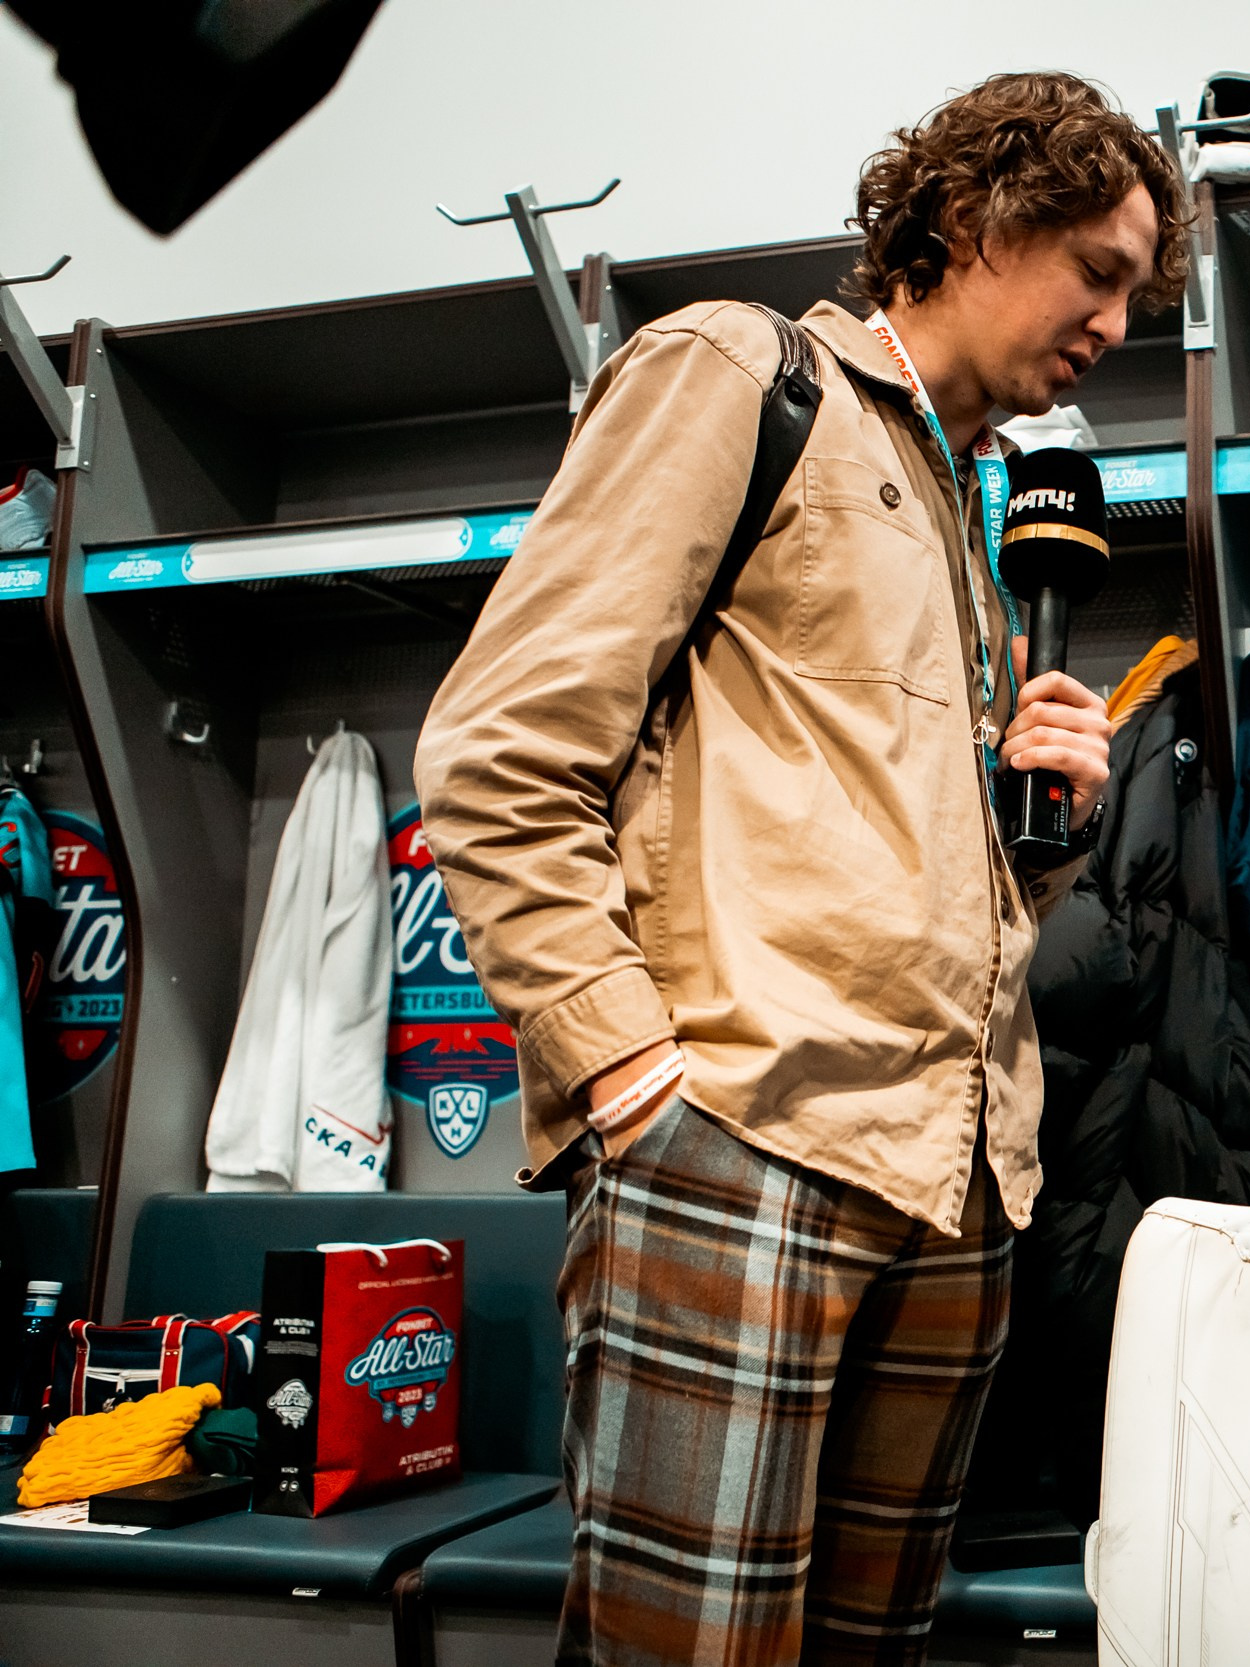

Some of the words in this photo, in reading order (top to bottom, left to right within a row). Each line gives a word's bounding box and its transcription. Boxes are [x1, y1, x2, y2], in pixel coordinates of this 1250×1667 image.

[985, 466, 1002, 501] WEEK
[1101, 468, 1157, 489] ll-Star
[1007, 488, 1076, 518] МАТЧ!
[79, 1000, 120, 1017] 2023
[350, 1331, 456, 1380] All-Star
[398, 1389, 423, 1404] 2023
